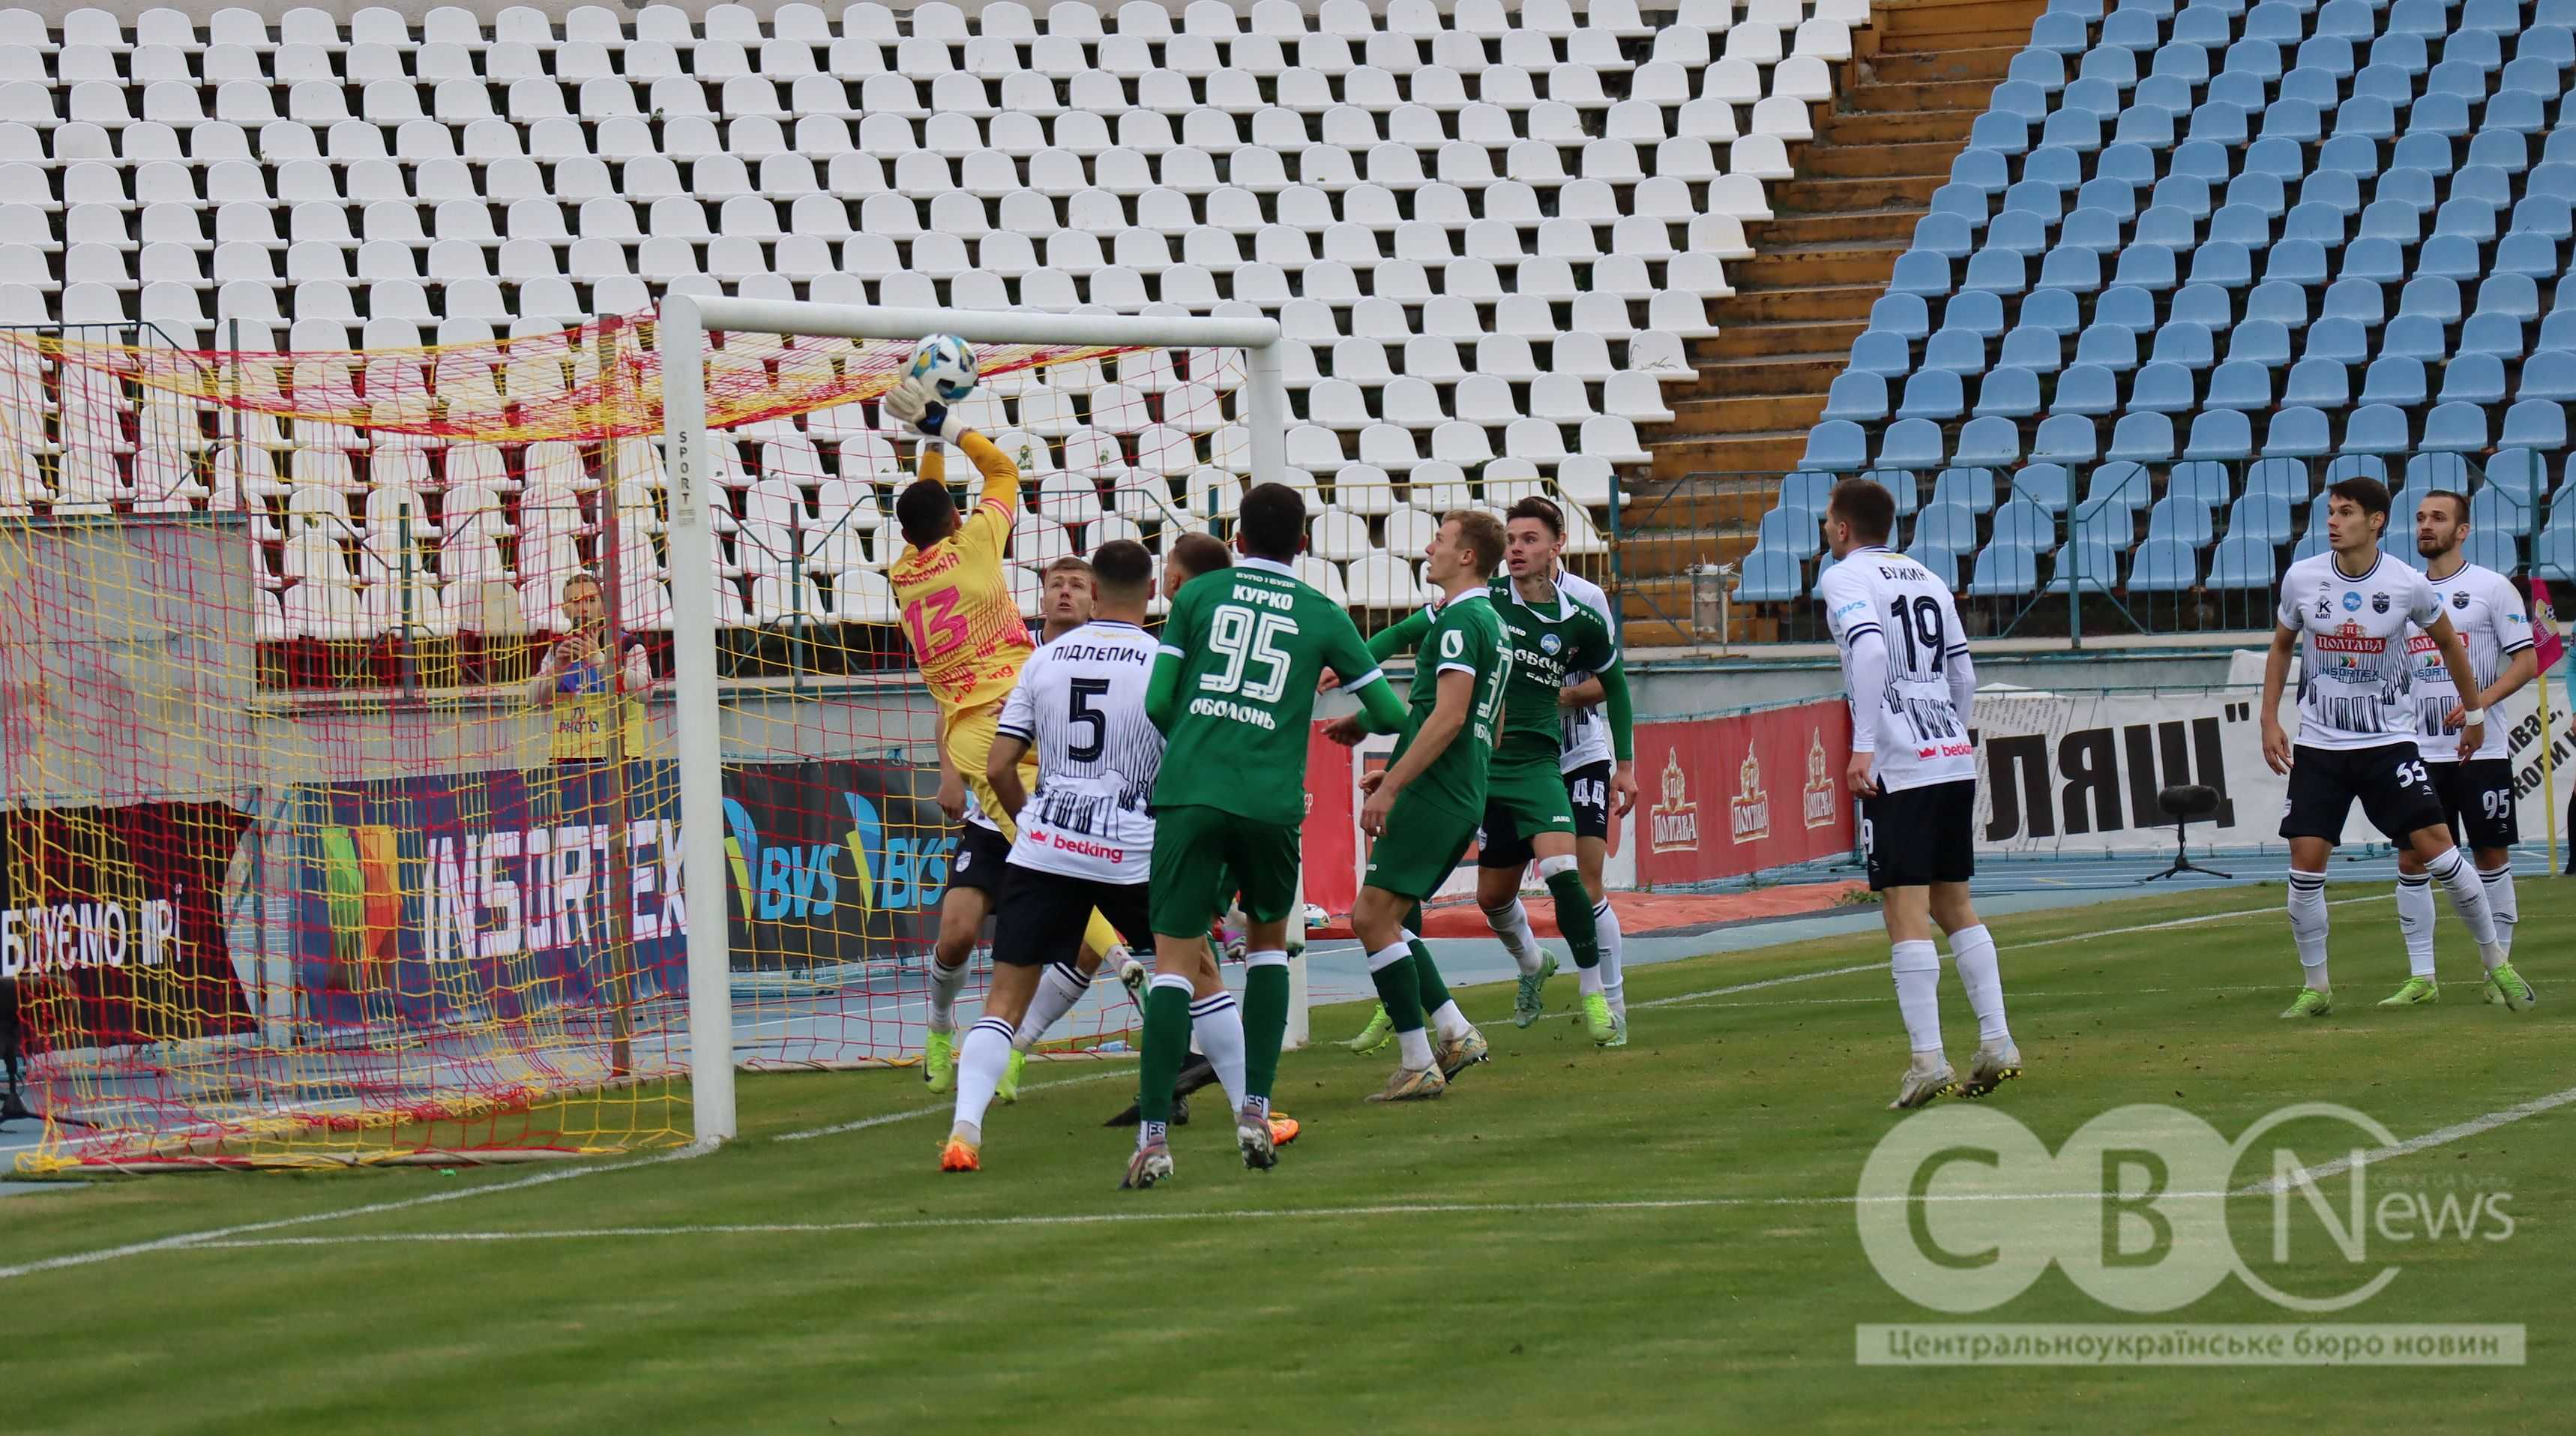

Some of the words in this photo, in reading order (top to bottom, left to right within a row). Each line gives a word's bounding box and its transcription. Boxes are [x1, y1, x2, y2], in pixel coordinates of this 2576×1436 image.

[679, 431, 690, 505] SPORT
[1879, 566, 1930, 582] БУЖИН
[1233, 584, 1294, 610] КУРКО
[904, 585, 969, 664] 13
[1891, 595, 1945, 672] 19
[1052, 645, 1147, 666] ПІДЛЕПИЧ
[1200, 604, 1299, 703] 95
[2317, 636, 2383, 651] ПОЛТАВА
[2320, 667, 2380, 678] INSORTEX
[1068, 678, 1110, 763] 5
[1190, 698, 1275, 730] ОБОЛОНЬ
[1572, 778, 1606, 810] 44
[2482, 789, 2511, 819] 95
[1654, 813, 1697, 844] ПОЛТАВА
[1053, 834, 1124, 863] betking
[759, 845, 839, 919] BVS
[881, 837, 958, 909] BVS
